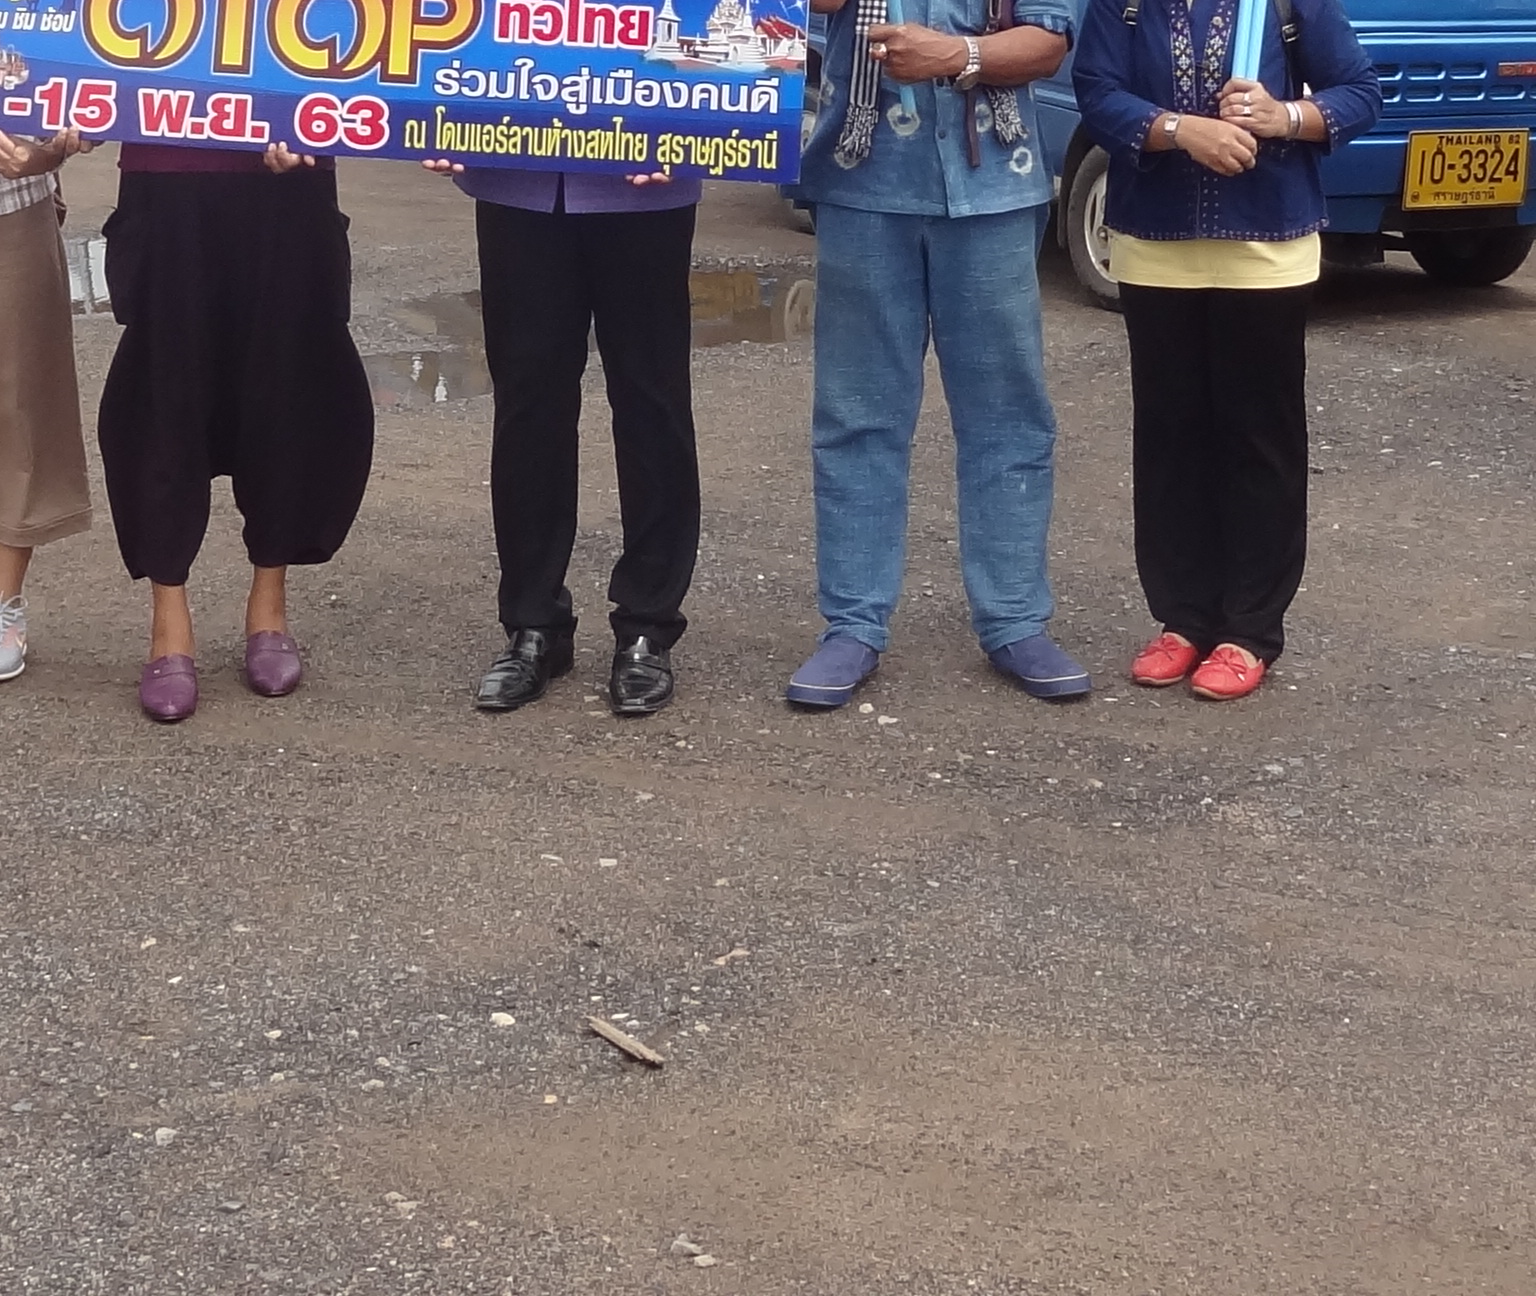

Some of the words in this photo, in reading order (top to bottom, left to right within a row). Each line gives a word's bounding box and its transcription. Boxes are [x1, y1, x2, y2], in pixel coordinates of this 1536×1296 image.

[12, 7, 36, 30] ชิม
[40, 6, 76, 32] ช้อป
[433, 57, 779, 116] ร่วมใจสู่เมืองคนดี
[3, 77, 117, 133] -15
[138, 88, 270, 144] พ.ย.
[294, 92, 390, 150] 63
[404, 118, 426, 150] ณ
[434, 106, 647, 163] โดมแอร์ลานห้างสหไทย
[657, 129, 778, 176] สุราษฎร์ธานี
[1437, 134, 1501, 146] THAILAND
[1418, 147, 1520, 186] 10-3324
